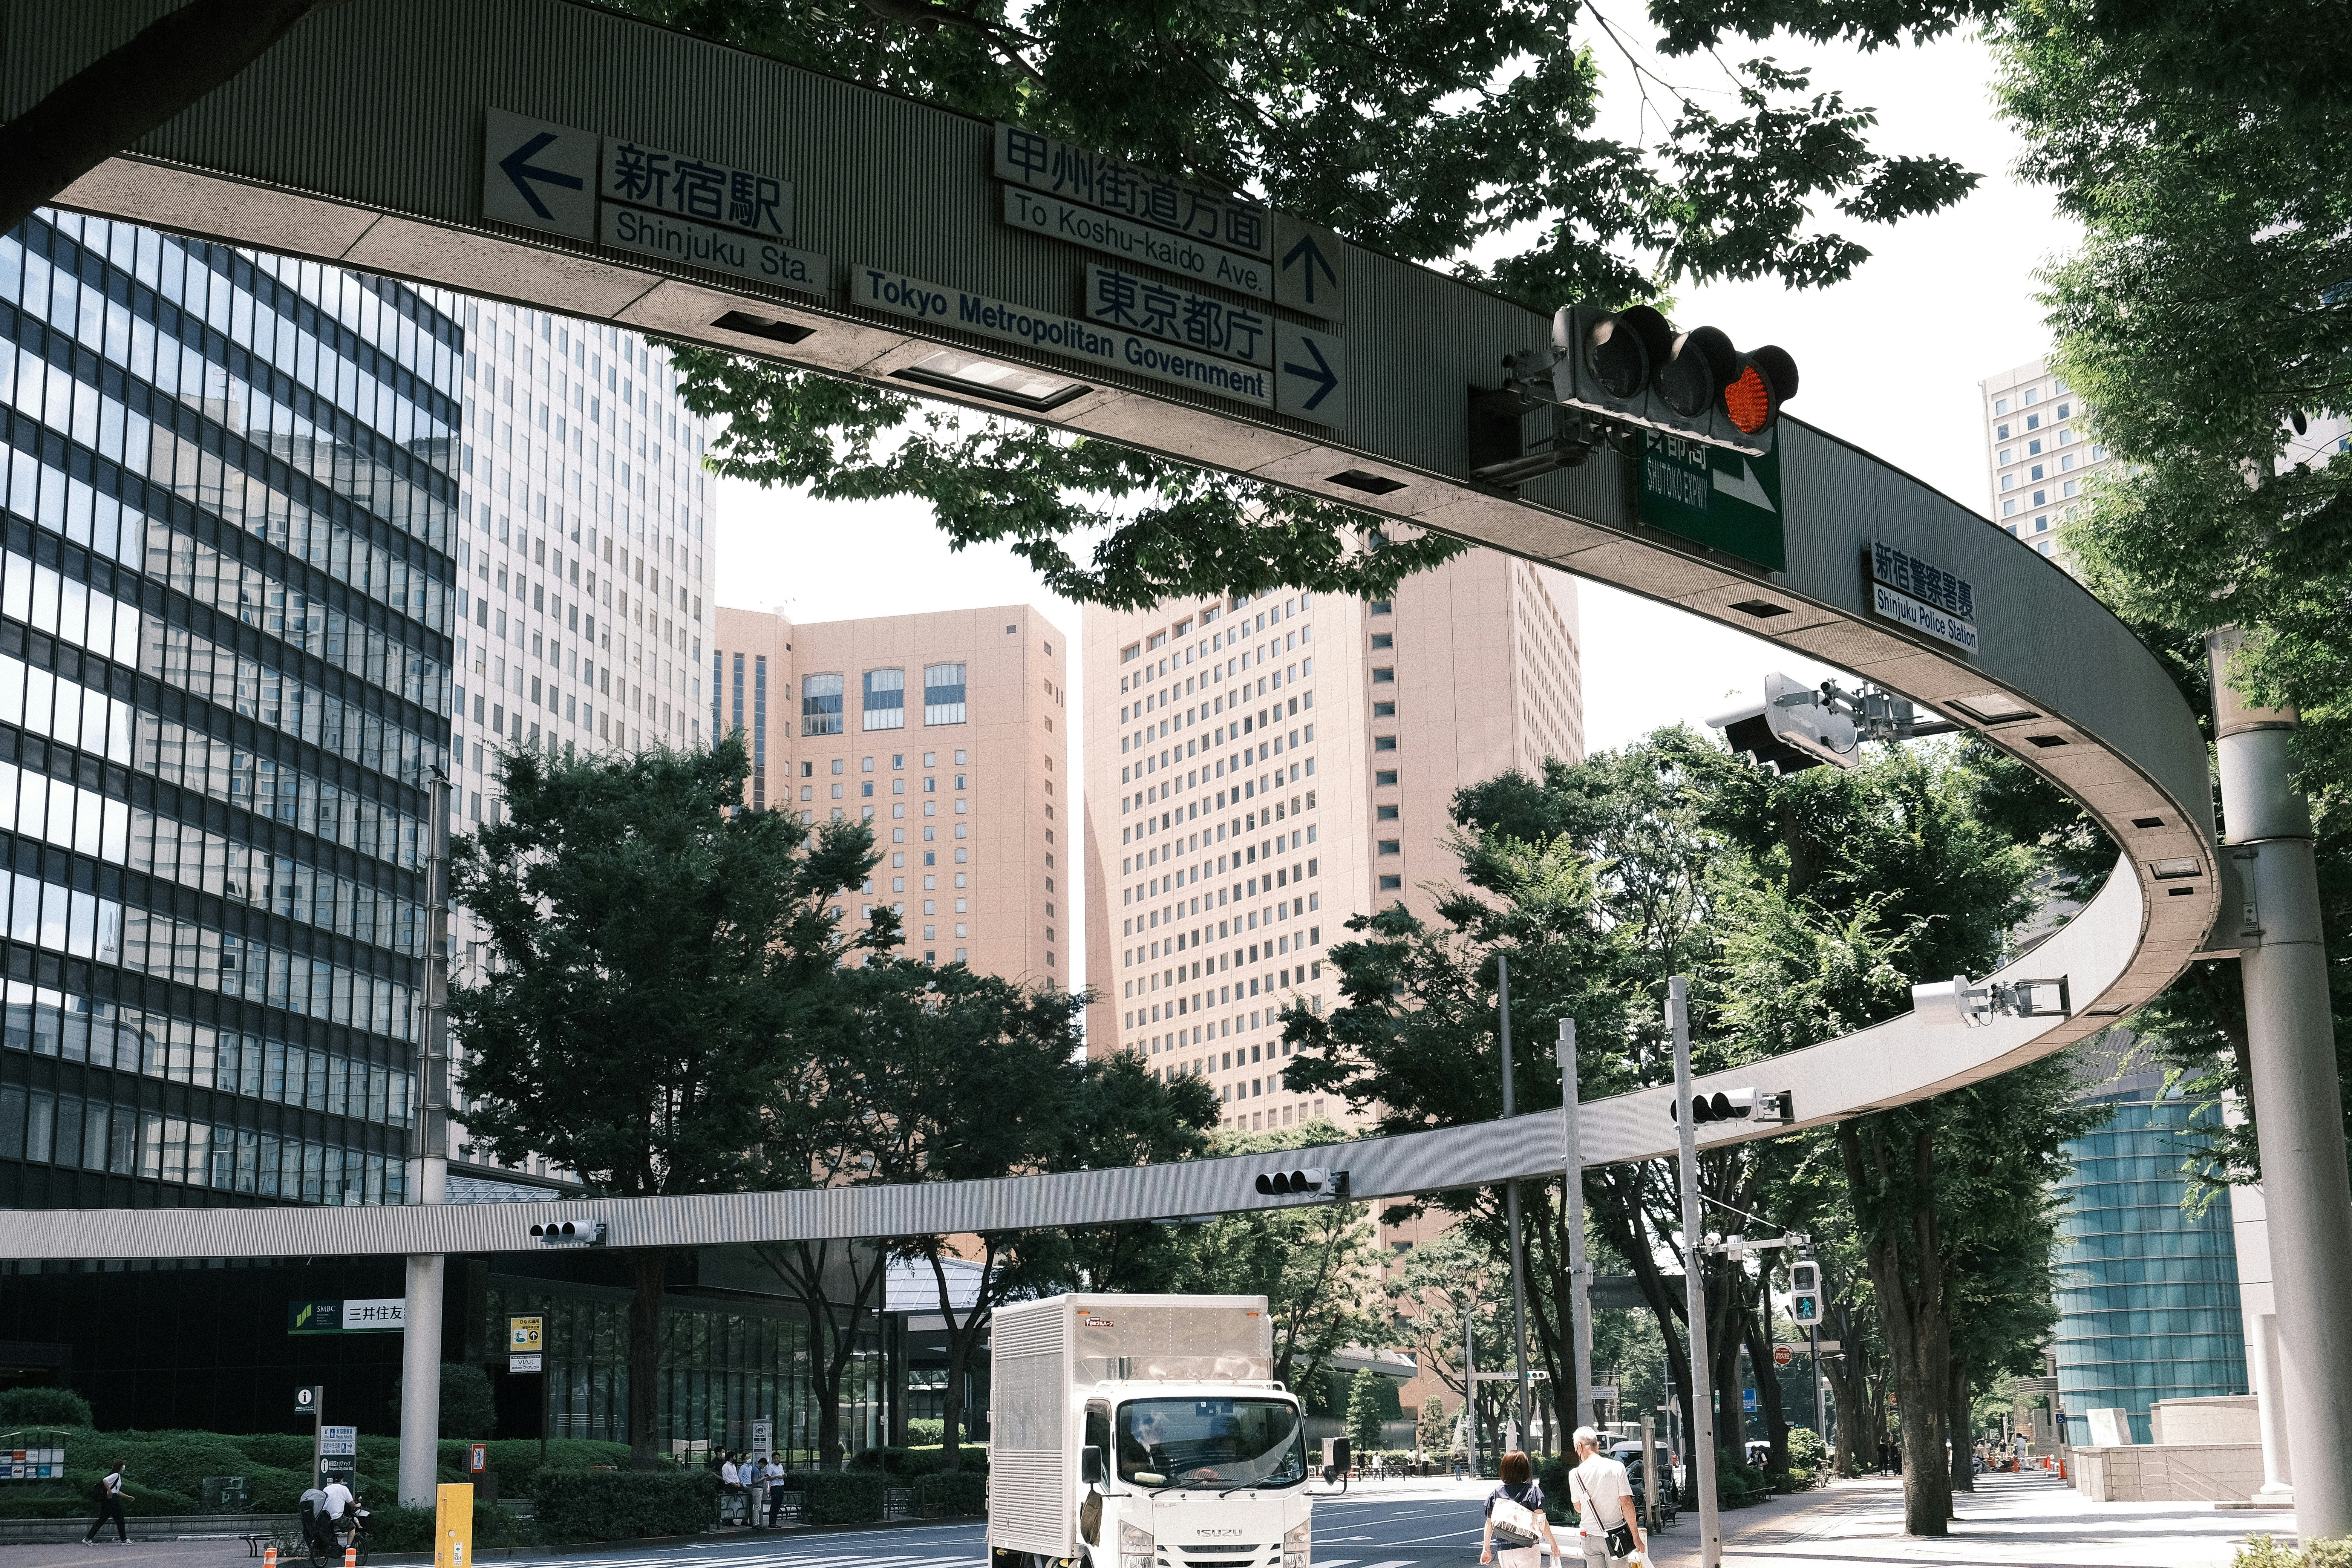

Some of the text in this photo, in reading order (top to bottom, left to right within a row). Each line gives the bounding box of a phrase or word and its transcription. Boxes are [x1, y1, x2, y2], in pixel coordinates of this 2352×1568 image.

[614, 142, 783, 234] 新宿駅
[1008, 127, 1262, 252] 甲州街道方面
[616, 211, 813, 284] Shinjuku Sta.
[1014, 192, 1262, 291] To Koshu-kaido Ave.
[866, 270, 1265, 398] Tokyo Metropolitan Government
[1095, 268, 1264, 360] 東京都庁
[1647, 456, 1708, 511] SHUTOKO EXPWY
[1875, 540, 1974, 621] 新宿警察署裏
[1877, 588, 1976, 648] Shinjuku Police Station
[349, 1305, 406, 1321] 三井住友
[1197, 1529, 1243, 1537] ISUZU
